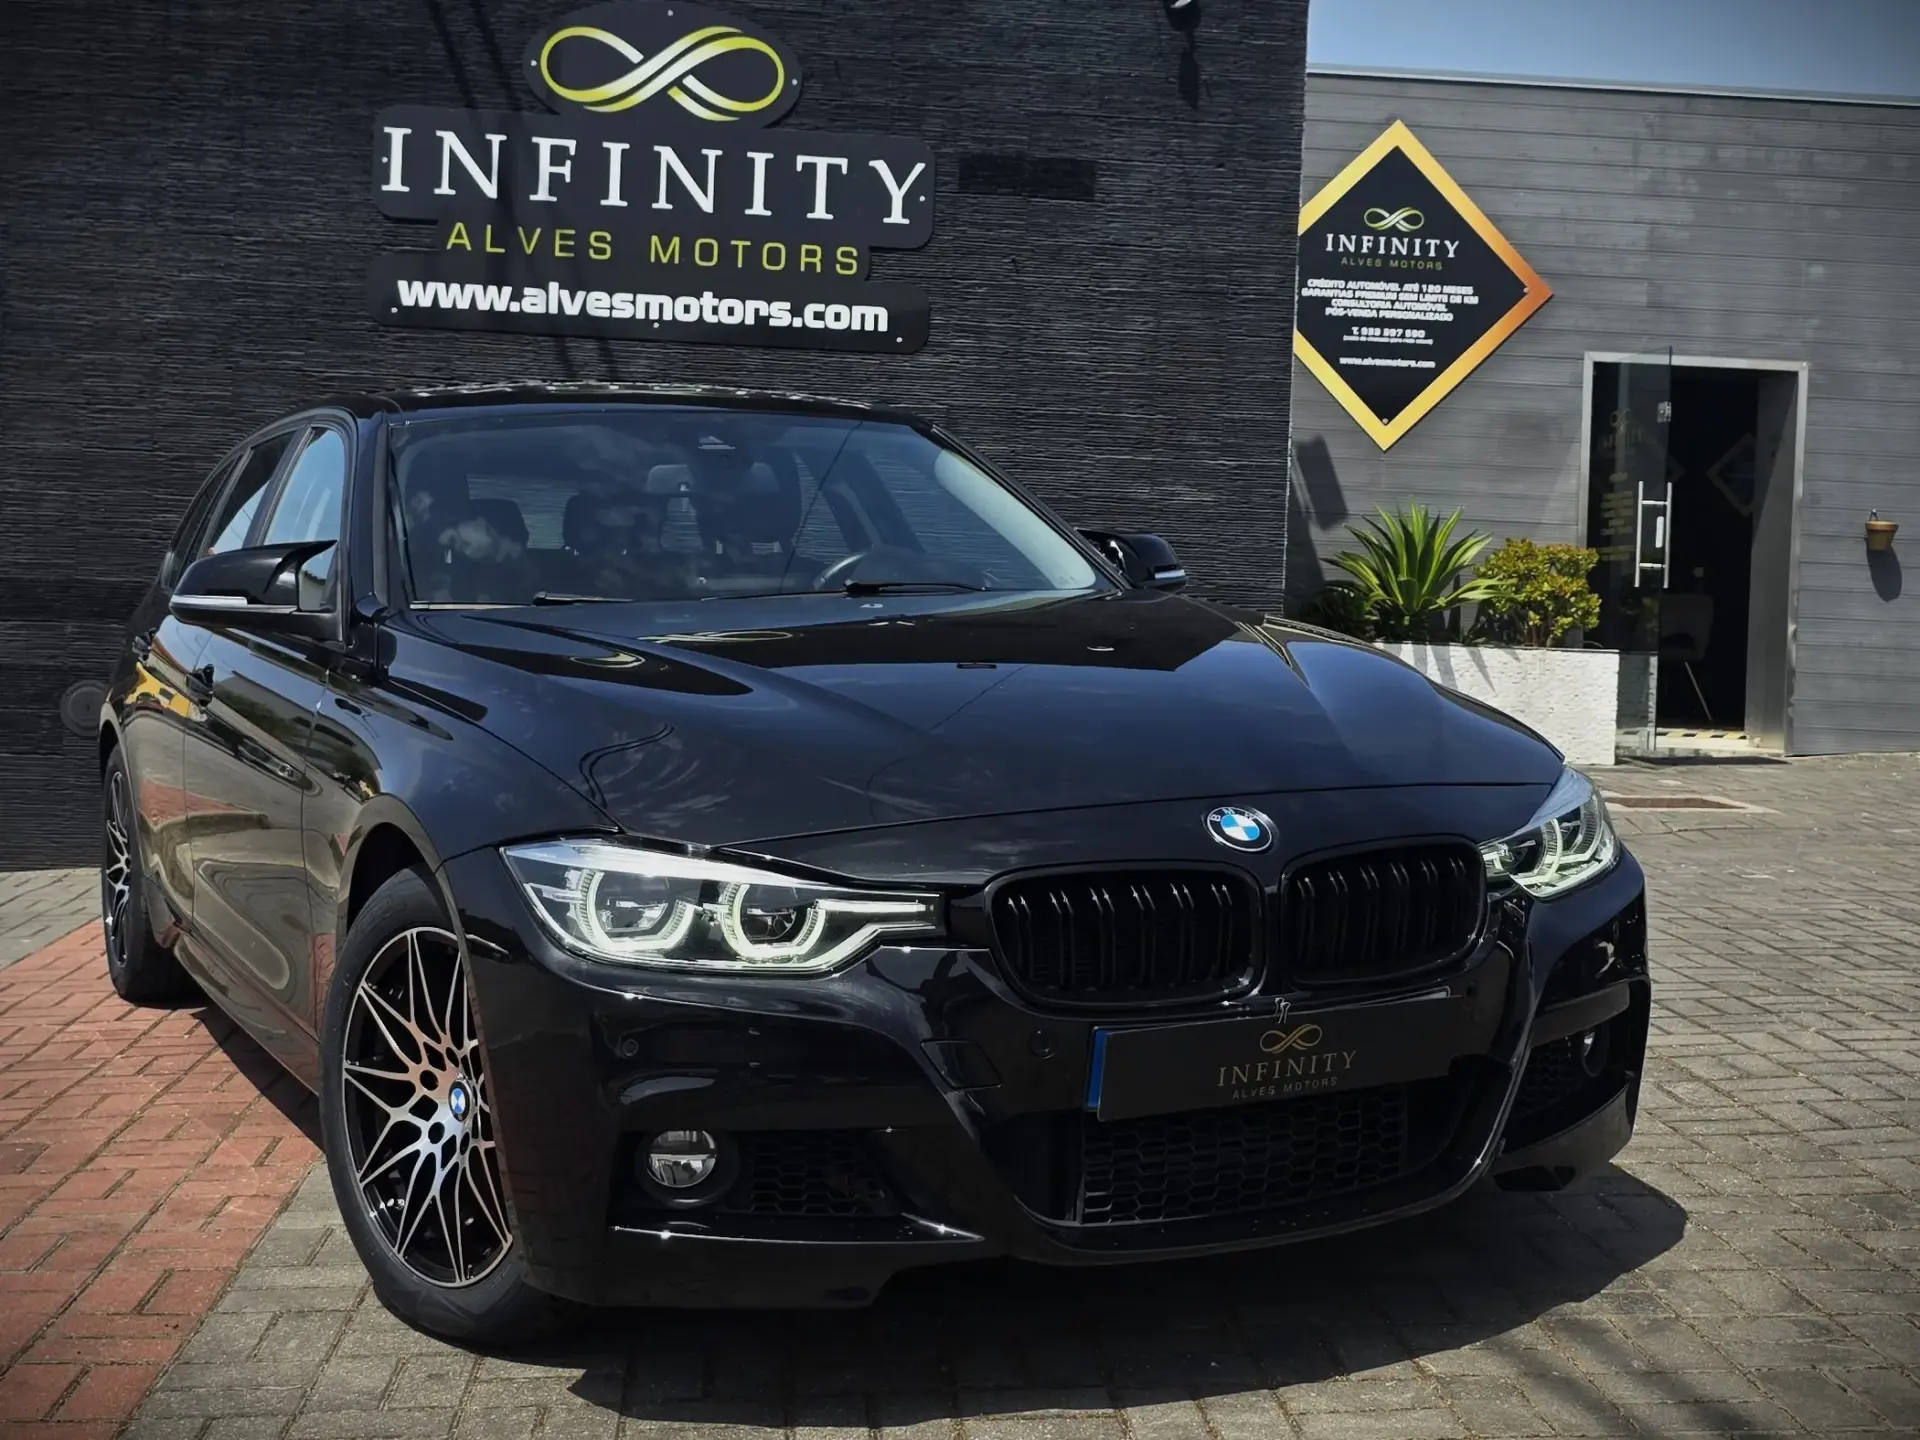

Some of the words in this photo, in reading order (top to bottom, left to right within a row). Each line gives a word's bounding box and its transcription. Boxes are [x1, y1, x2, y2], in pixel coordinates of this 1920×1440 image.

[381, 126, 927, 225] INFINITY
[446, 222, 613, 260] ALVES
[650, 235, 859, 275] MOTORS
[1325, 233, 1460, 258] INFINITY
[1341, 257, 1382, 267] ALVES
[1389, 259, 1443, 271] MOTORS
[397, 279, 889, 332] www.alvesmotors.com
[1217, 1050, 1357, 1087] INFINITY
[1232, 1085, 1277, 1099] ALVES
[1283, 1076, 1339, 1093] MOTORS
